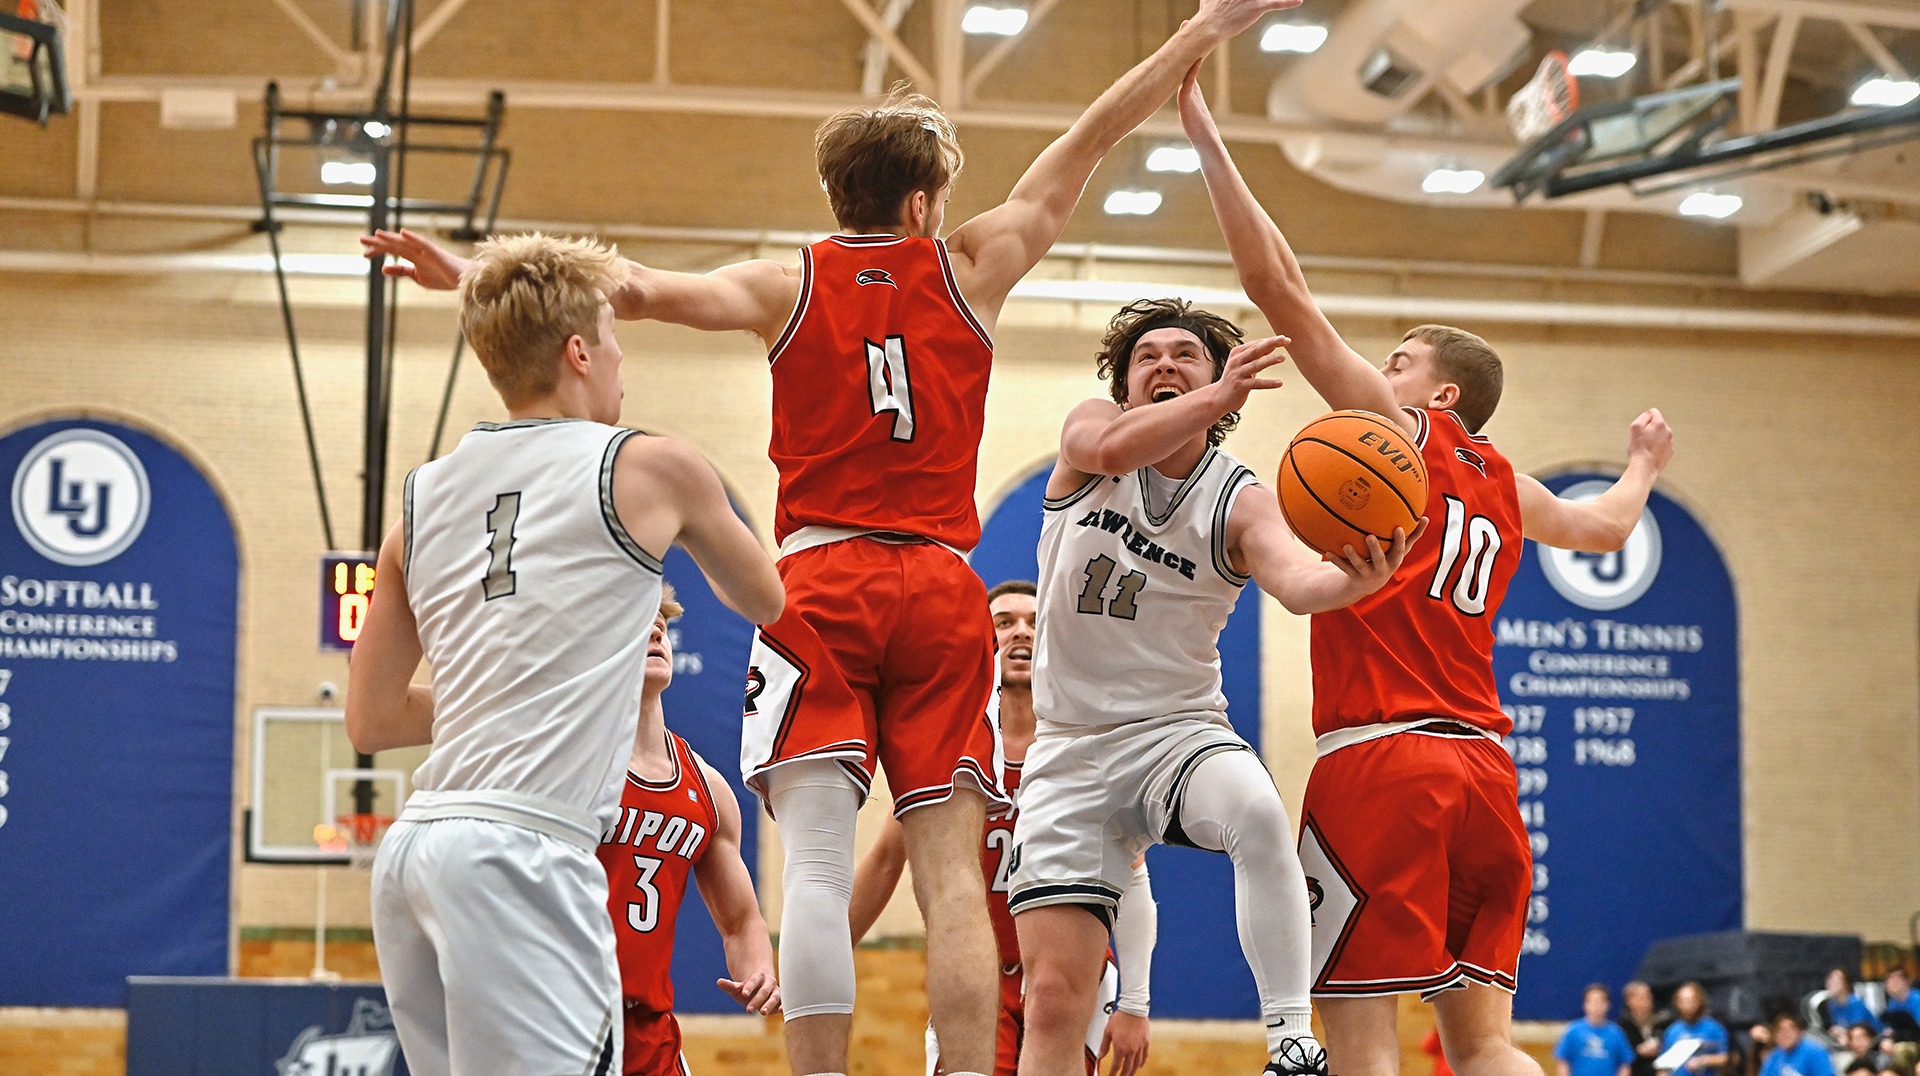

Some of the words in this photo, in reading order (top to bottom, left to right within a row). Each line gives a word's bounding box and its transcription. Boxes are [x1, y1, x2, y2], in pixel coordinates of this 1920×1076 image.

[864, 334, 916, 443] 4
[1358, 431, 1413, 473] EVO
[1411, 467, 1422, 483] NXT
[47, 458, 112, 538] LU
[481, 490, 522, 601] 1
[1076, 508, 1197, 581] AWENCE
[1426, 492, 1503, 617] 10
[0, 575, 159, 610] SOFTBALL
[1077, 553, 1147, 620] 11
[0, 610, 156, 638] CONFERENCE
[1497, 617, 1587, 650] MEN'S
[1591, 619, 1703, 652] TENNIS
[0, 636, 178, 663] HAMPIONSHIPS
[1529, 650, 1669, 677] CONFERENCE
[1510, 672, 1691, 700] CHAMPIONSHIPS
[1501, 704, 1546, 733] 937
[1574, 706, 1634, 734] 1957
[1502, 736, 1548, 765] 938
[1575, 738, 1636, 767] 1968
[1518, 768, 1548, 796] 39
[601, 805, 706, 860] RIPON
[626, 854, 663, 932] 3
